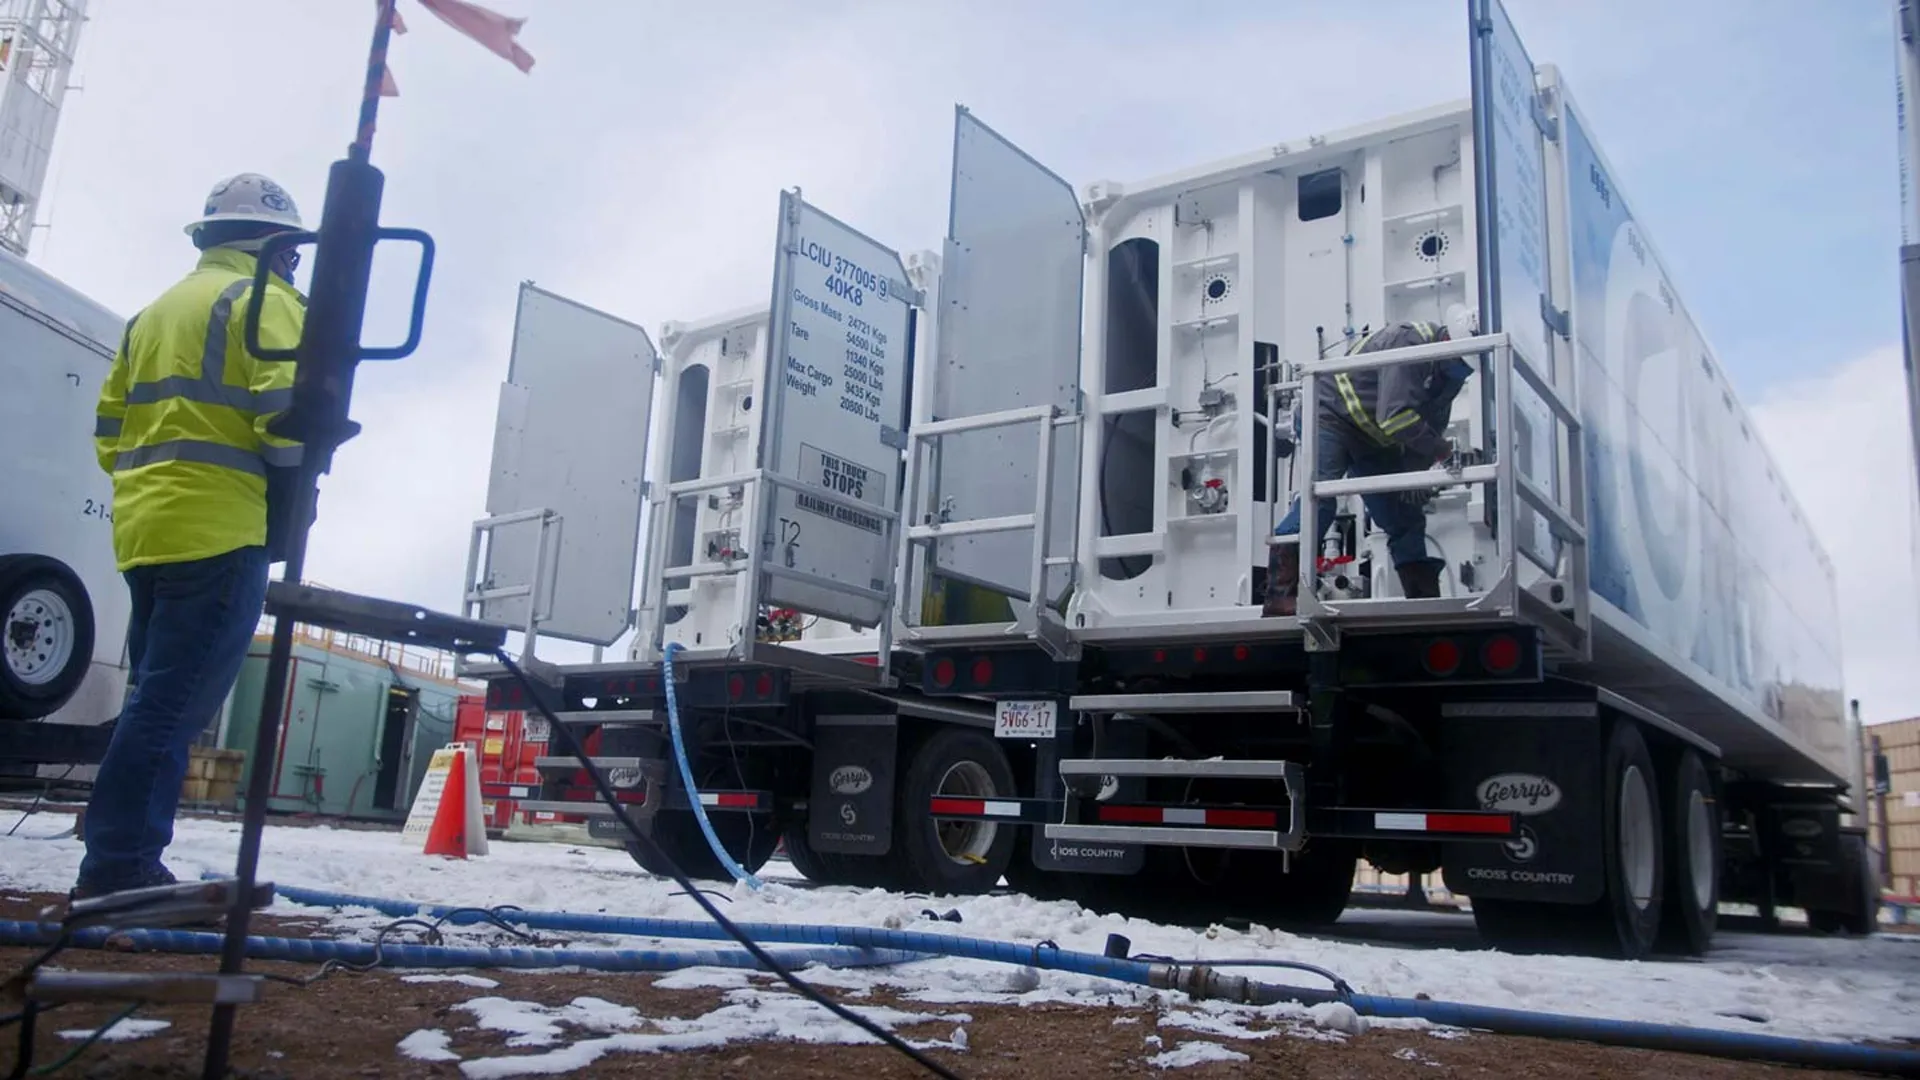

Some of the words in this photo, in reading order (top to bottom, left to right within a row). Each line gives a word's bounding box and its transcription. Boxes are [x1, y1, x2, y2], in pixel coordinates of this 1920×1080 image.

[800, 238, 832, 268] LCIU
[834, 256, 876, 292] 377005
[880, 280, 886, 297] 9
[825, 274, 862, 306] 40K8
[794, 288, 818, 311] Gross
[821, 302, 842, 322] Mass
[848, 315, 870, 335] 24721
[872, 328, 887, 345] Kgs
[791, 321, 809, 340] Tare
[846, 349, 868, 368] 11340
[869, 360, 884, 376] Kgs
[846, 332, 869, 350] 54500
[870, 344, 884, 358] Lbs
[788, 356, 806, 374] Max
[807, 364, 833, 387] Cargo
[845, 381, 864, 399] 9435
[865, 391, 881, 408] Kgs
[844, 364, 868, 384] 25000
[868, 376, 883, 391] Lbs
[786, 373, 816, 396] Weight
[865, 407, 880, 422] Lbs
[821, 454, 840, 471] THIS
[842, 462, 868, 481] TRUCK
[822, 468, 864, 500] STOPS
[798, 494, 836, 516] RAILWAY
[780, 517, 800, 548] T2
[1484, 778, 1554, 808] Gerry's
[1080, 848, 1124, 858] COUNTRY
[1468, 868, 1508, 880] CROSS
[1511, 871, 1574, 884] COUNTRY
